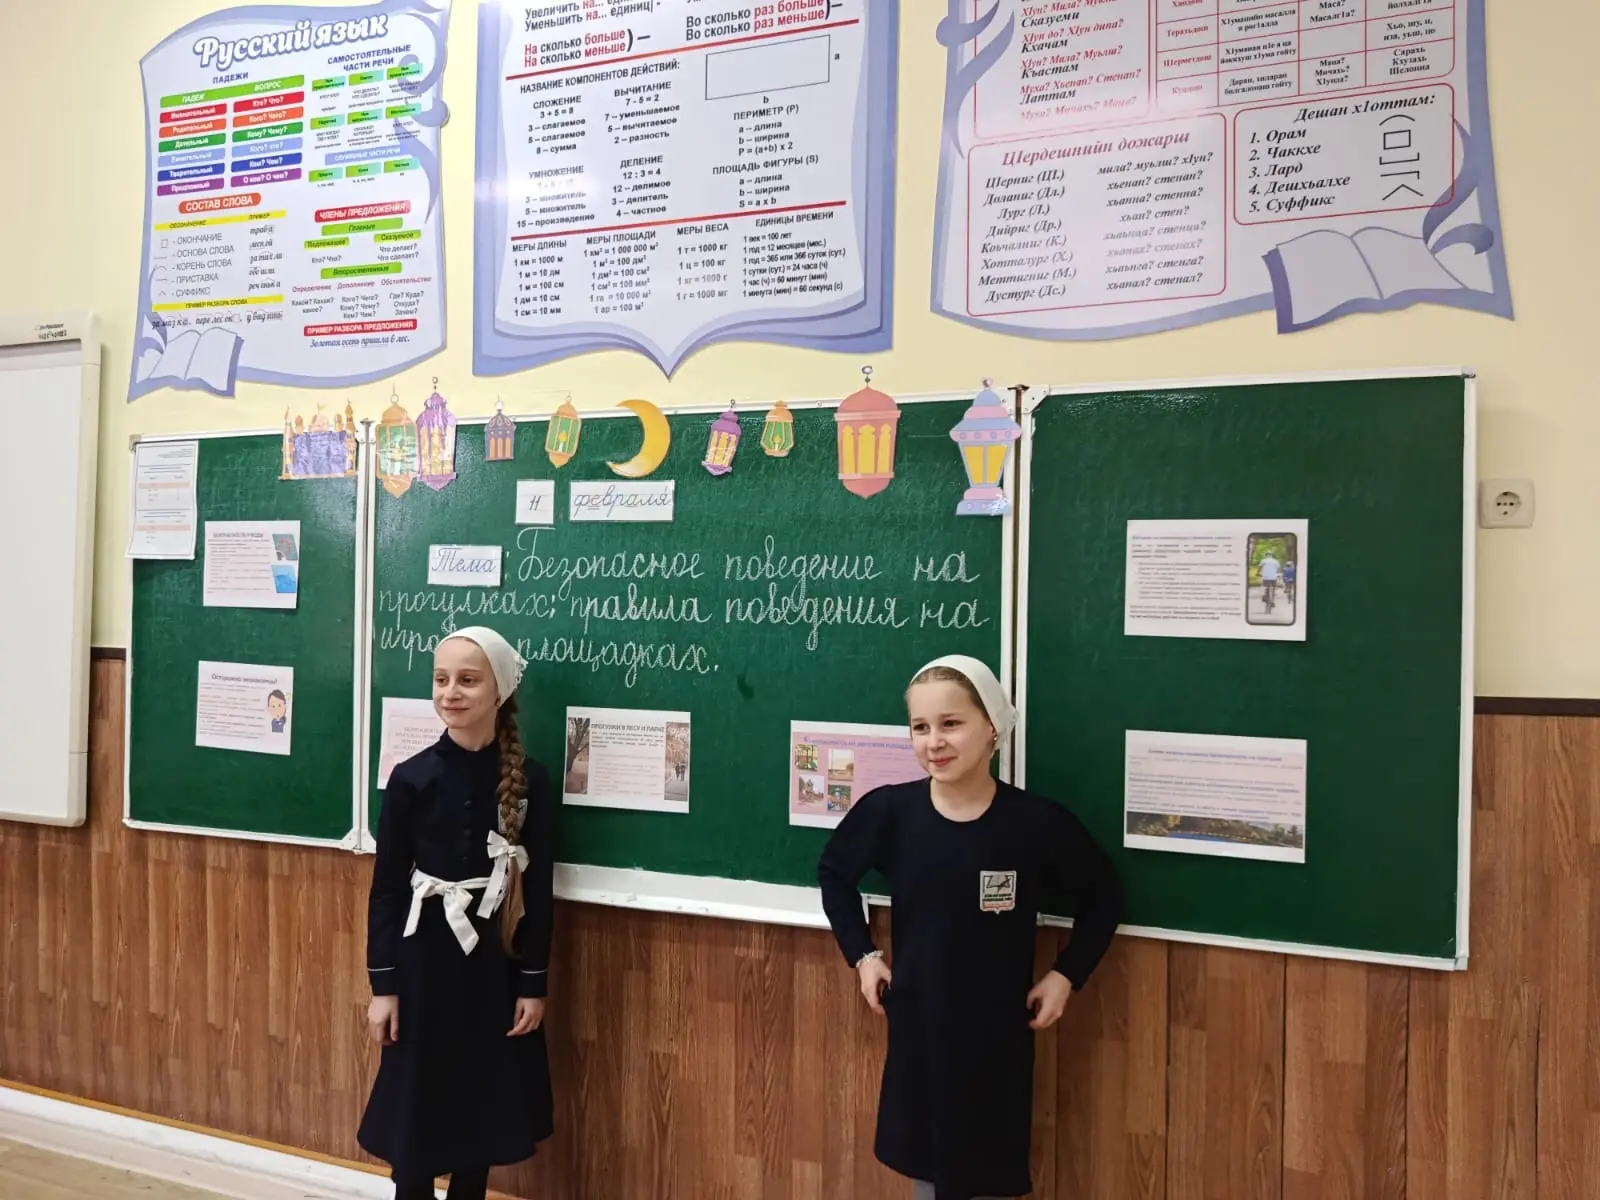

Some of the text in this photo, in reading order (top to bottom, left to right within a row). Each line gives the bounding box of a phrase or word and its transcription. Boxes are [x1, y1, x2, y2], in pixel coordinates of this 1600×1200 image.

[525, 5, 579, 20] Увеличить
[686, 16, 700, 27] Во
[705, 9, 750, 25] сколько
[754, 4, 773, 18] раз
[1021, 11, 1079, 28] Сказуеми
[525, 11, 607, 32] Уменьшить на...
[686, 9, 824, 40] Во сколько раз меньше
[193, 14, 388, 71] Русский язык
[525, 30, 625, 55] На сколько больше
[1021, 39, 1068, 53] Кхачам
[328, 45, 411, 64] САМОСТОЯТЕЛЬНЫЕ
[525, 42, 626, 68] На сколько меньше
[344, 58, 394, 71] ЧАСТИ РЕЧИ
[1021, 63, 1078, 79] Къастам
[213, 72, 248, 84] ПАДЕЖИ
[521, 59, 680, 94] НАЗВАНИЕ КОМПОНЕНТОВ ДЕЙСТВИЙ:
[614, 81, 672, 96] ВЫЧИТАНИЕ
[533, 96, 582, 109] СЛОЖЕНИЕ
[1020, 89, 1076, 105] Латтам
[620, 105, 680, 120] уменьшаемое
[734, 106, 783, 120] ПЕРИМЕТР
[1294, 104, 1348, 123] Дешан
[542, 119, 585, 130] слагаемое
[622, 118, 677, 131] вычитаемое
[754, 121, 782, 132] длина
[542, 131, 585, 142] слагаемое
[629, 132, 669, 143] разность
[755, 132, 790, 143] ширина
[1118, 133, 1190, 150] дожарш
[1250, 128, 1307, 143] 1. Орам
[550, 144, 576, 154] сумма
[1249, 144, 1321, 161] 2. Чаккхе
[620, 156, 663, 168] ДЕЛЕНИЕ
[713, 155, 819, 175] ПЛОЩАДЬ ФИГУРЫ (S)
[1097, 162, 1132, 175] мила?
[529, 166, 584, 178] УМНОЖЕНИЕ
[1249, 163, 1303, 178] 3. Лард
[632, 181, 670, 192] делимое
[754, 174, 782, 184] длина
[1249, 176, 1350, 195] 4. Дешхьалхе
[755, 184, 790, 195] ширина
[983, 186, 1065, 206] Доланиг (Дл.)
[186, 196, 253, 211] СОСТАВ СЛОВА
[627, 194, 668, 204] делитель
[1249, 195, 1335, 213] 5. Суффикс
[320, 203, 406, 219] ЧЛЕНЫ ПРЕДЛОЖЕНИЯ
[539, 203, 586, 214] множитель
[631, 206, 666, 215] частное
[997, 204, 1050, 221] Лург (Л.)
[1155, 206, 1190, 218] стен?
[535, 214, 594, 227] произведение
[756, 212, 833, 227] ЕДИНИЦЫ ВРЕМЕНИ
[677, 223, 729, 235] МЕРЫ ВЕСА
[986, 219, 1062, 238] Дийриг (Др.)
[178, 234, 222, 245] ОКОНЧАНИЕ
[586, 231, 656, 245] МЕРЫ ПЛОЩАДИ
[177, 245, 234, 258] ОСНОВА СЛОВА
[513, 240, 566, 252] МЕРЫ ДЛИНЫ
[176, 259, 232, 271] КОРЕНЬ СЛОВА
[176, 274, 219, 283] ПРИСТАВКА
[176, 287, 210, 297] СУФФИКС
[985, 284, 1066, 303] Дустург (Дс.)
[574, 485, 671, 518] февраля
[431, 547, 496, 574] Тема
[516, 526, 980, 612] Безопасное поведение на
[569, 582, 713, 635] правила
[726, 582, 910, 650] поведения
[920, 600, 990, 629] на
